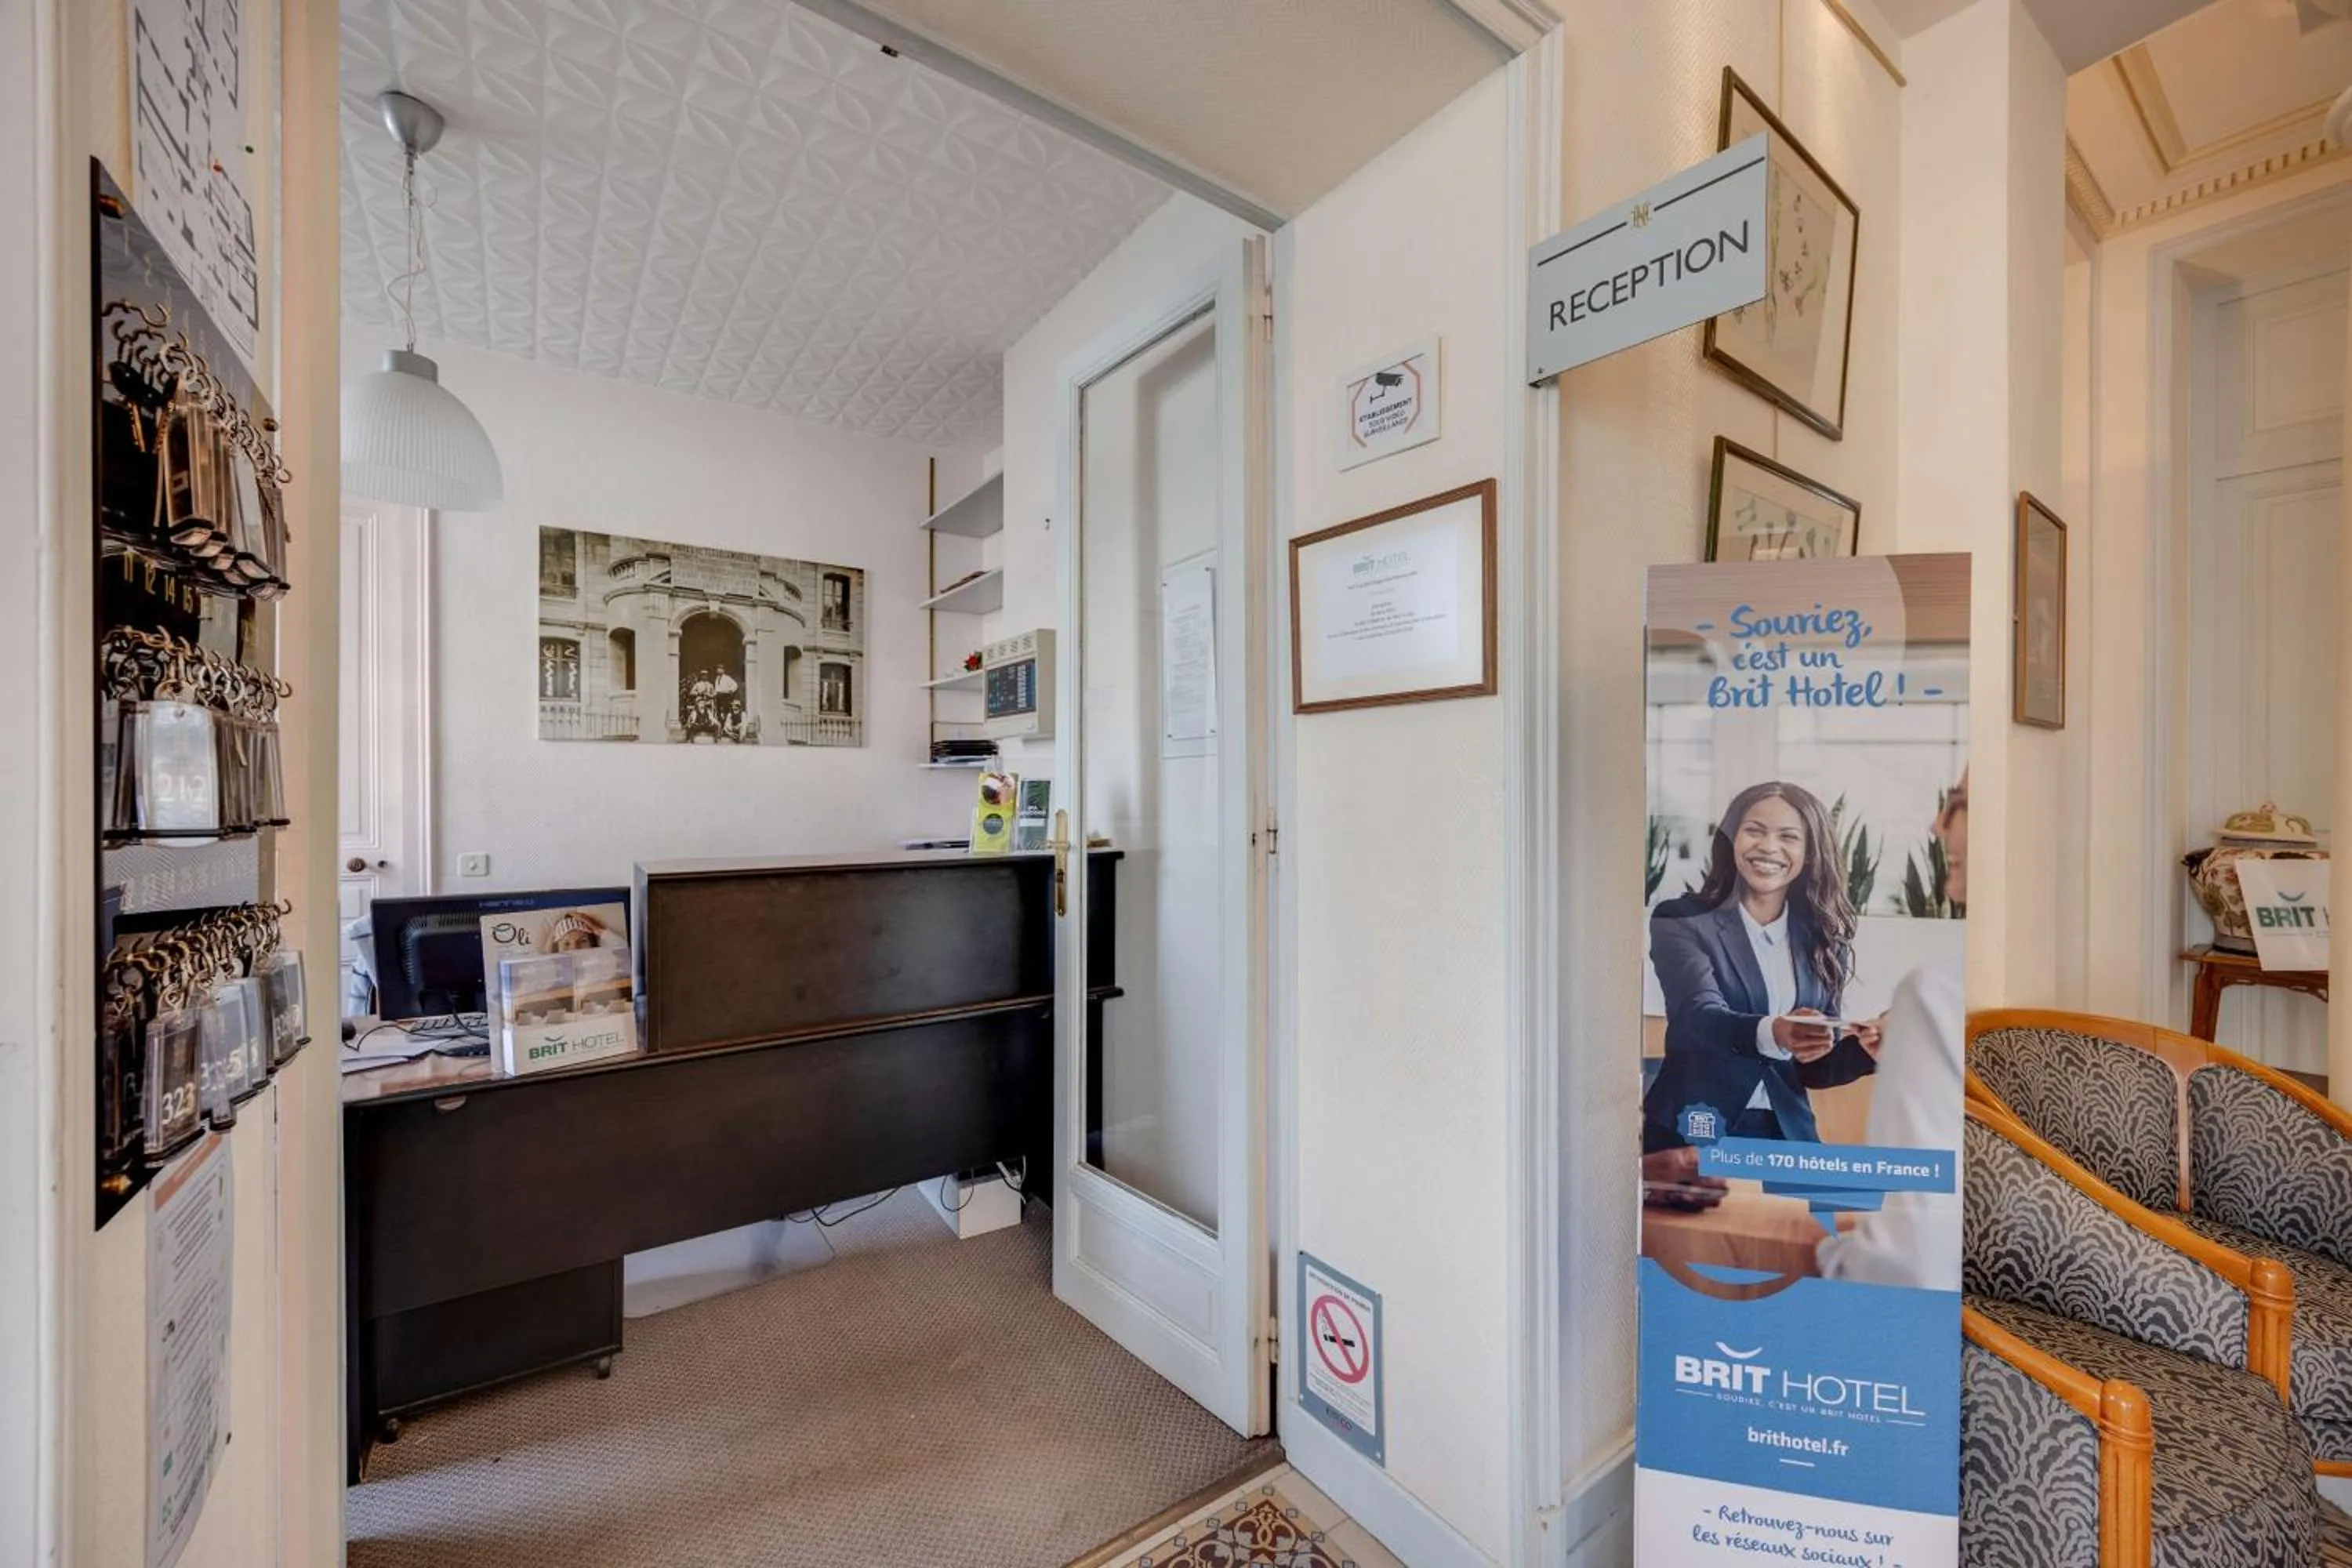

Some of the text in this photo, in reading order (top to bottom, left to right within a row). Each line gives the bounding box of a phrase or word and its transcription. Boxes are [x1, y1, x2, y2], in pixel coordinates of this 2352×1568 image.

[1550, 220, 1748, 331] RECEPTION
[1730, 604, 1872, 648] Souriez,
[1733, 642, 1843, 671] c'est un
[1708, 673, 1773, 707] Brit
[1786, 670, 1888, 706] Hotel
[2256, 906, 2315, 927] BRIT
[492, 923, 531, 946] Oli
[529, 1032, 624, 1059] BRIT HOTEL
[162, 1083, 195, 1124] 323
[1711, 1149, 1740, 1166] Plus
[1745, 1152, 1763, 1167] de
[1767, 1154, 1794, 1167] 170
[1799, 1155, 1848, 1173] hôtels
[1853, 1163, 1872, 1174] en
[1877, 1161, 1930, 1178] France
[1675, 1355, 1926, 1416] BRIT HOTEL
[1801, 1405, 1816, 1414] UN
[1820, 1408, 1843, 1418] BRIT
[1848, 1412, 1881, 1424] HOTEL
[1748, 1426, 1849, 1457] brithotel.fr
[1719, 1504, 1859, 1541] Retrouvez-nous
[1863, 1530, 1894, 1547] sur
[1693, 1524, 1720, 1546] les
[1726, 1532, 1796, 1558] réseaux
[1801, 1547, 1872, 1568] sociaux
